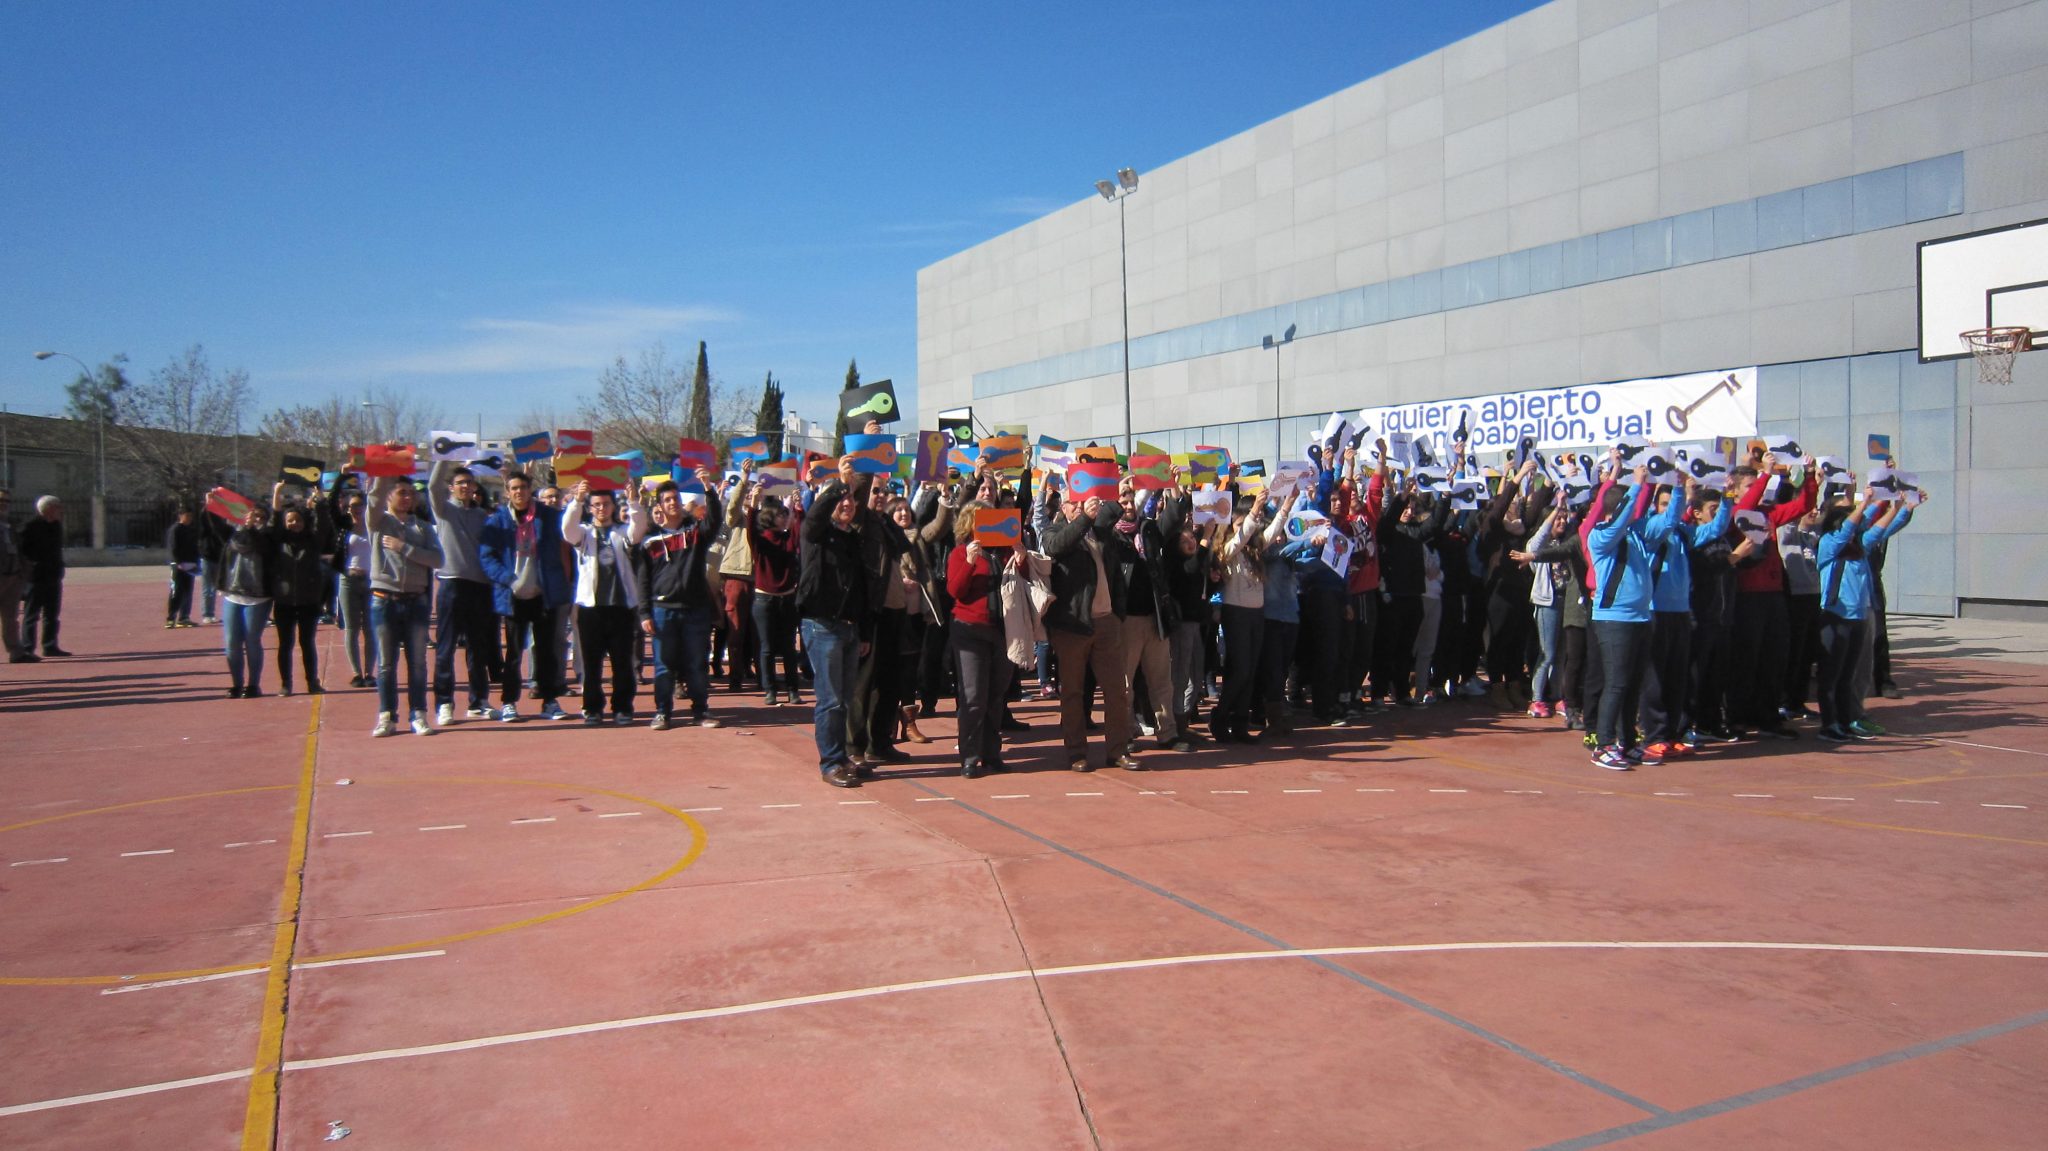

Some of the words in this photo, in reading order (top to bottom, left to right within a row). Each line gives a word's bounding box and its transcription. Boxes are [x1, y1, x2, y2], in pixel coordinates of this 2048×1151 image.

[1380, 404, 1472, 435] ¡quier
[1481, 389, 1601, 423] abierto
[1470, 414, 1595, 451] pabellón,
[1604, 409, 1652, 440] ya!
